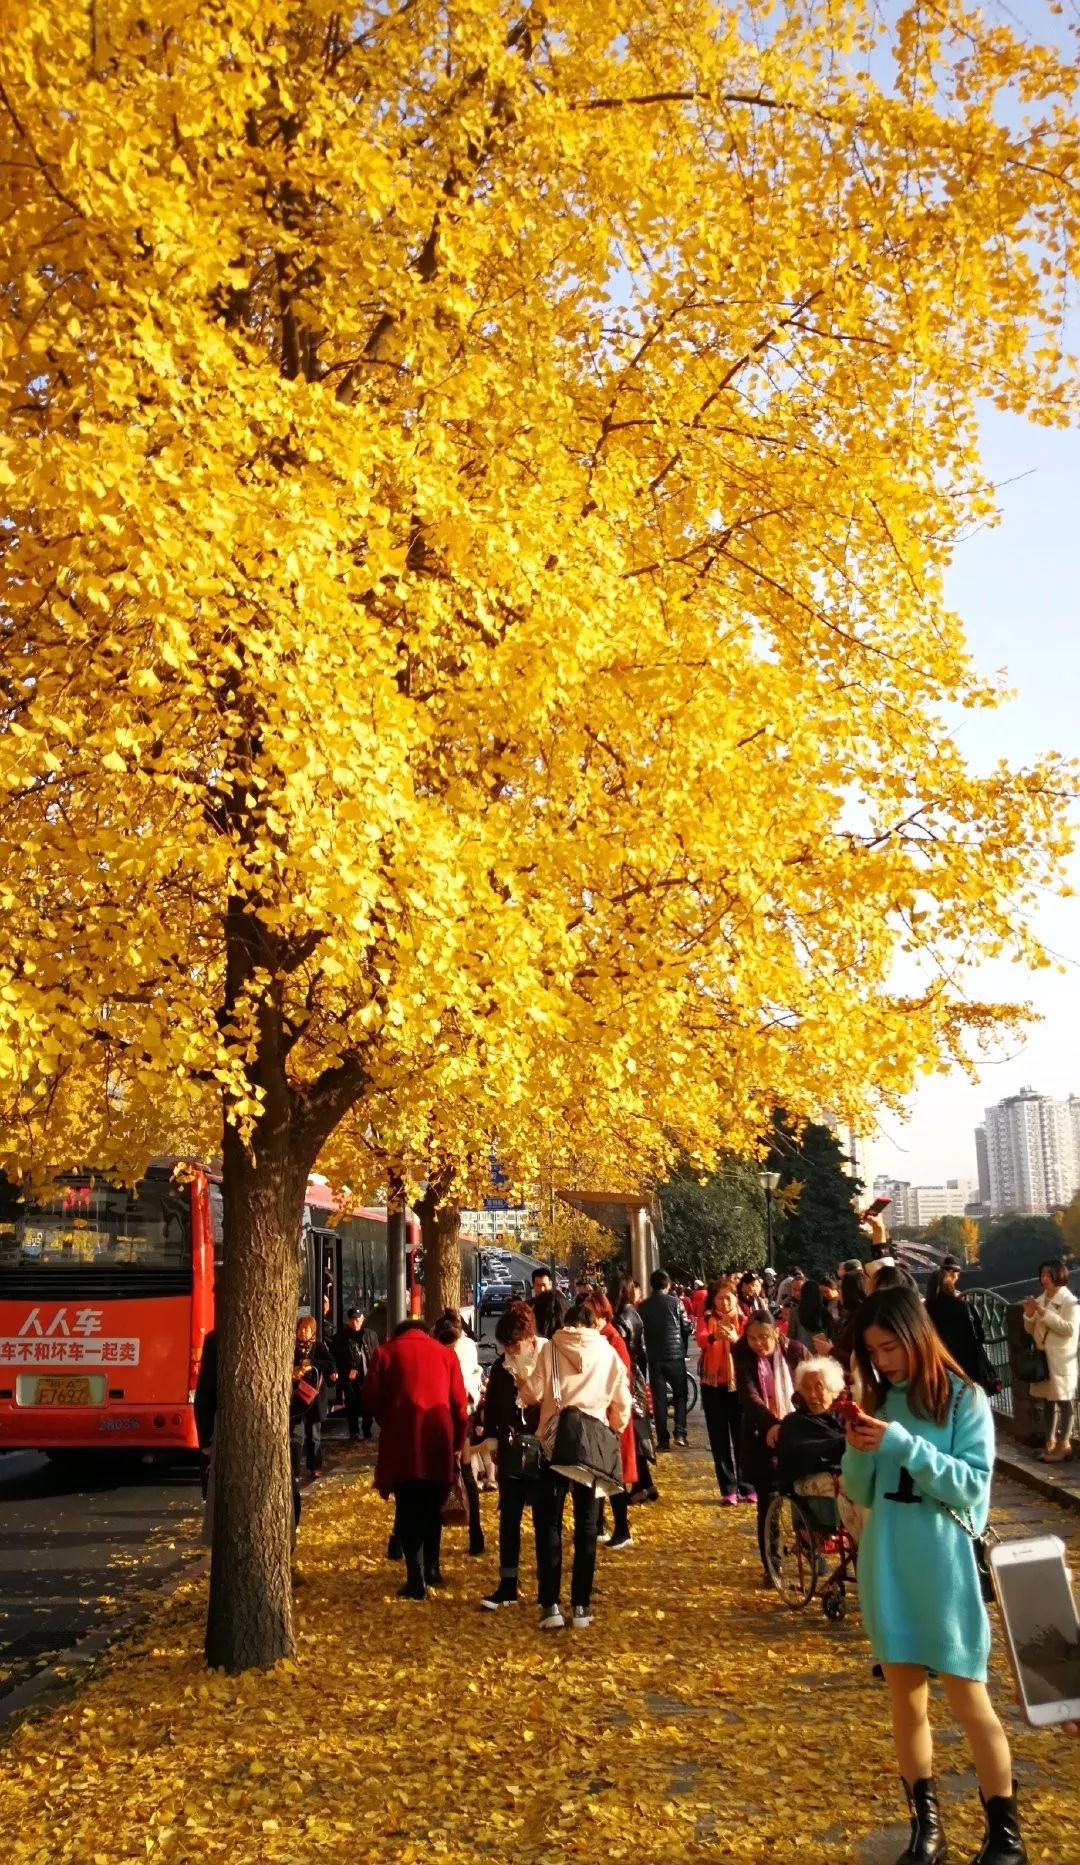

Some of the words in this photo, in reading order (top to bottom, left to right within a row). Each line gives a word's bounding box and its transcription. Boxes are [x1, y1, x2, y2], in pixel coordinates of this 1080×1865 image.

[18, 1308, 103, 1336] 人人车
[1, 1342, 136, 1361] 车不和坏车一起卖
